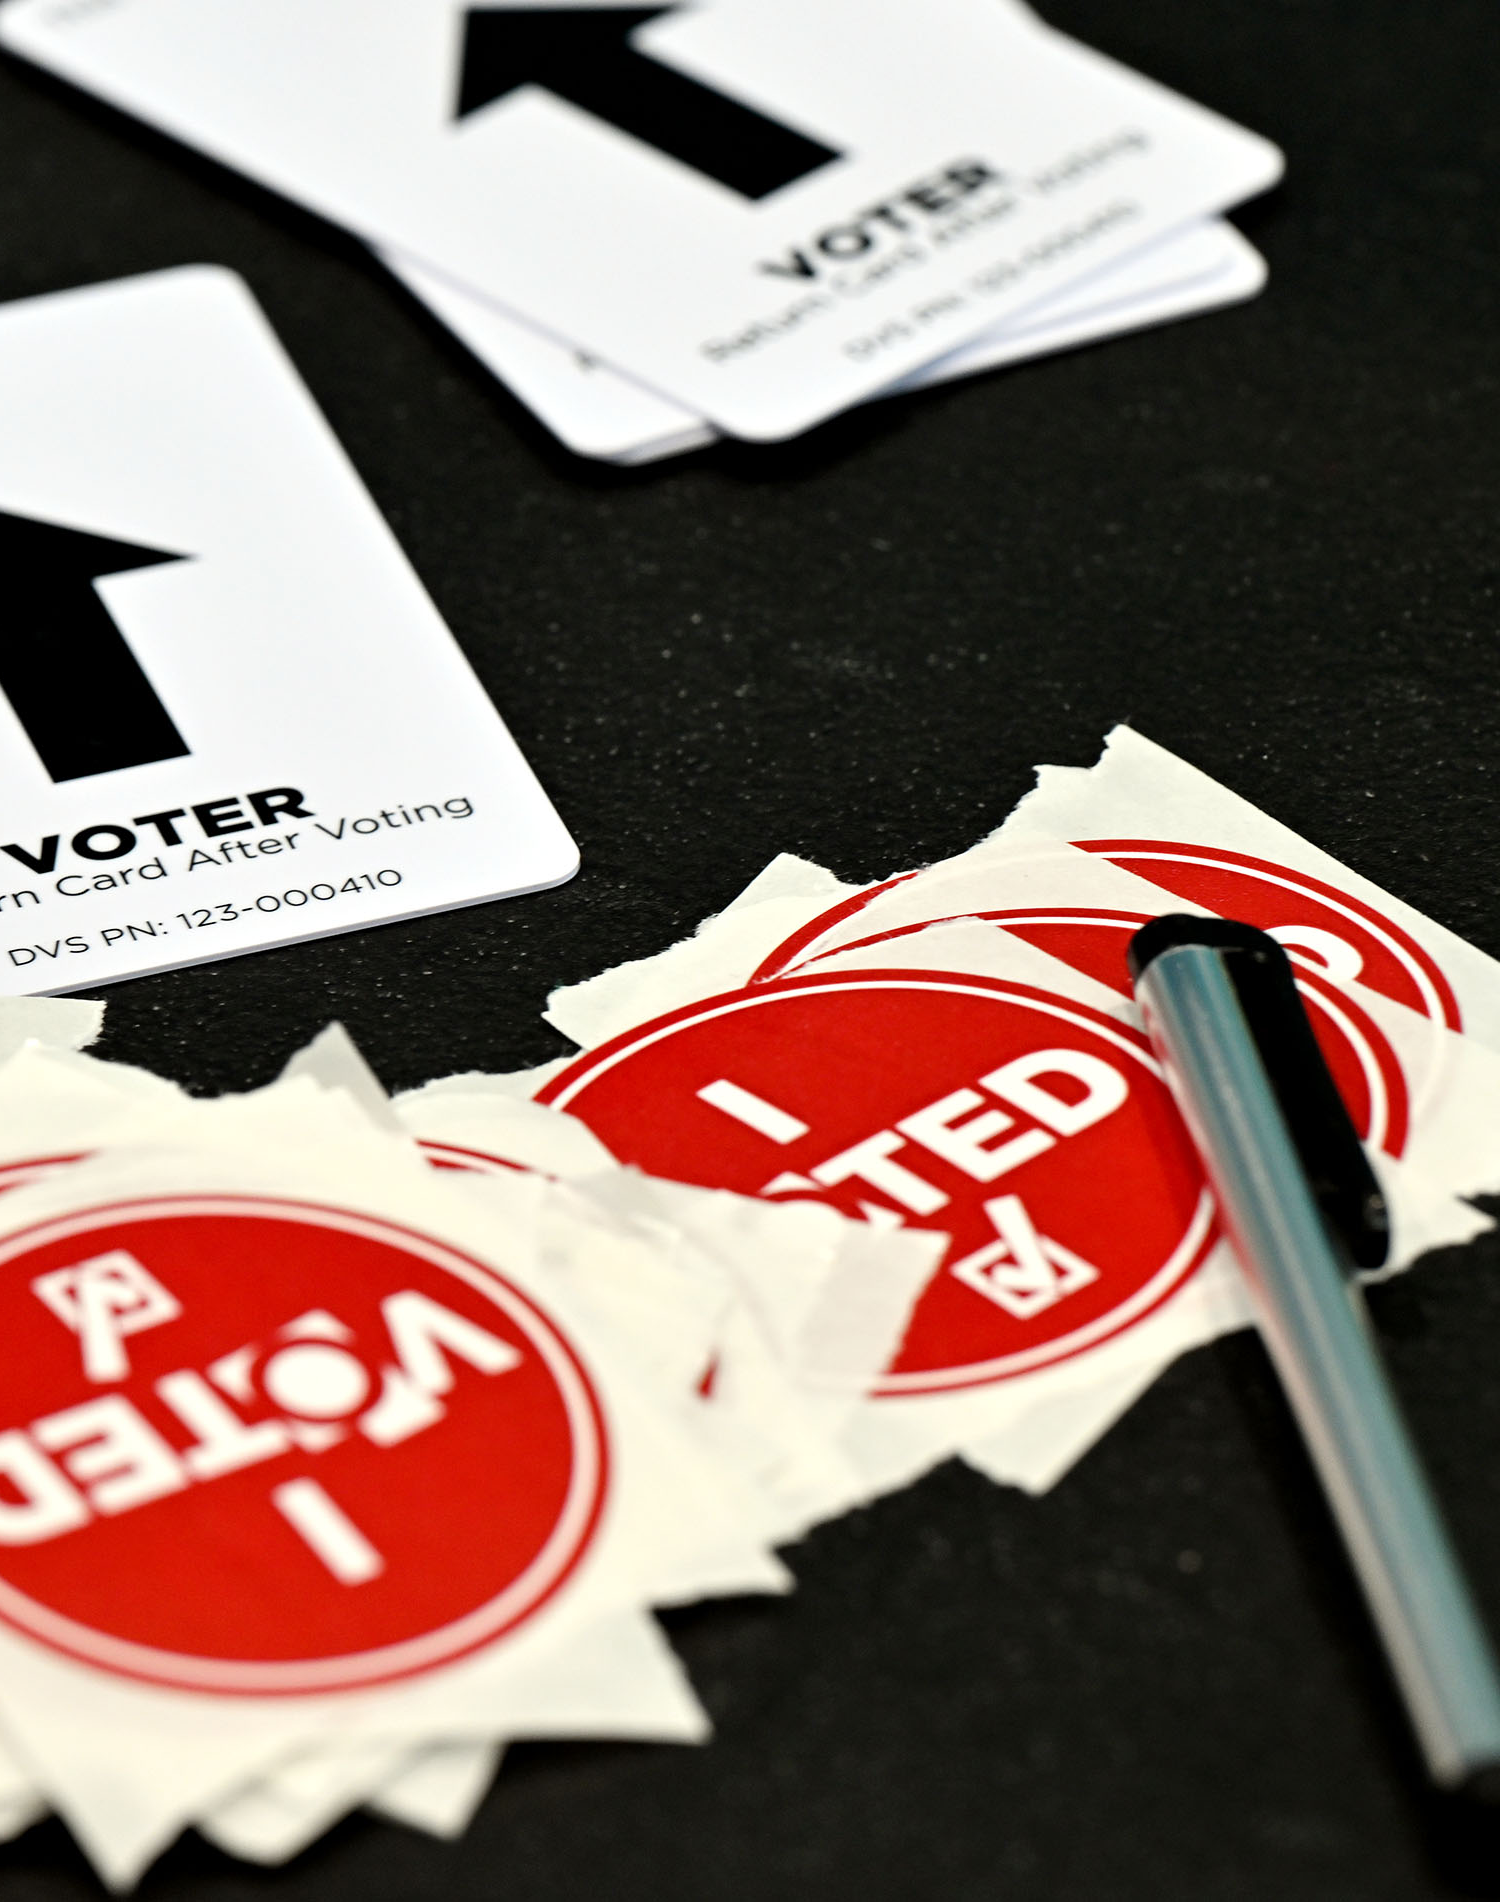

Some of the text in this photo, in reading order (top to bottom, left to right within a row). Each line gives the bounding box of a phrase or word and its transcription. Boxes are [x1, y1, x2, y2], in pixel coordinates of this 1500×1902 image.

[757, 157, 998, 283] VOTER
[55, 857, 168, 896] Card
[188, 831, 300, 872] After
[314, 797, 474, 840] Voting
[8, 869, 402, 967] DVS PN: 123-000410
[696, 1078, 811, 1145] I
[271, 1477, 384, 1586] I
